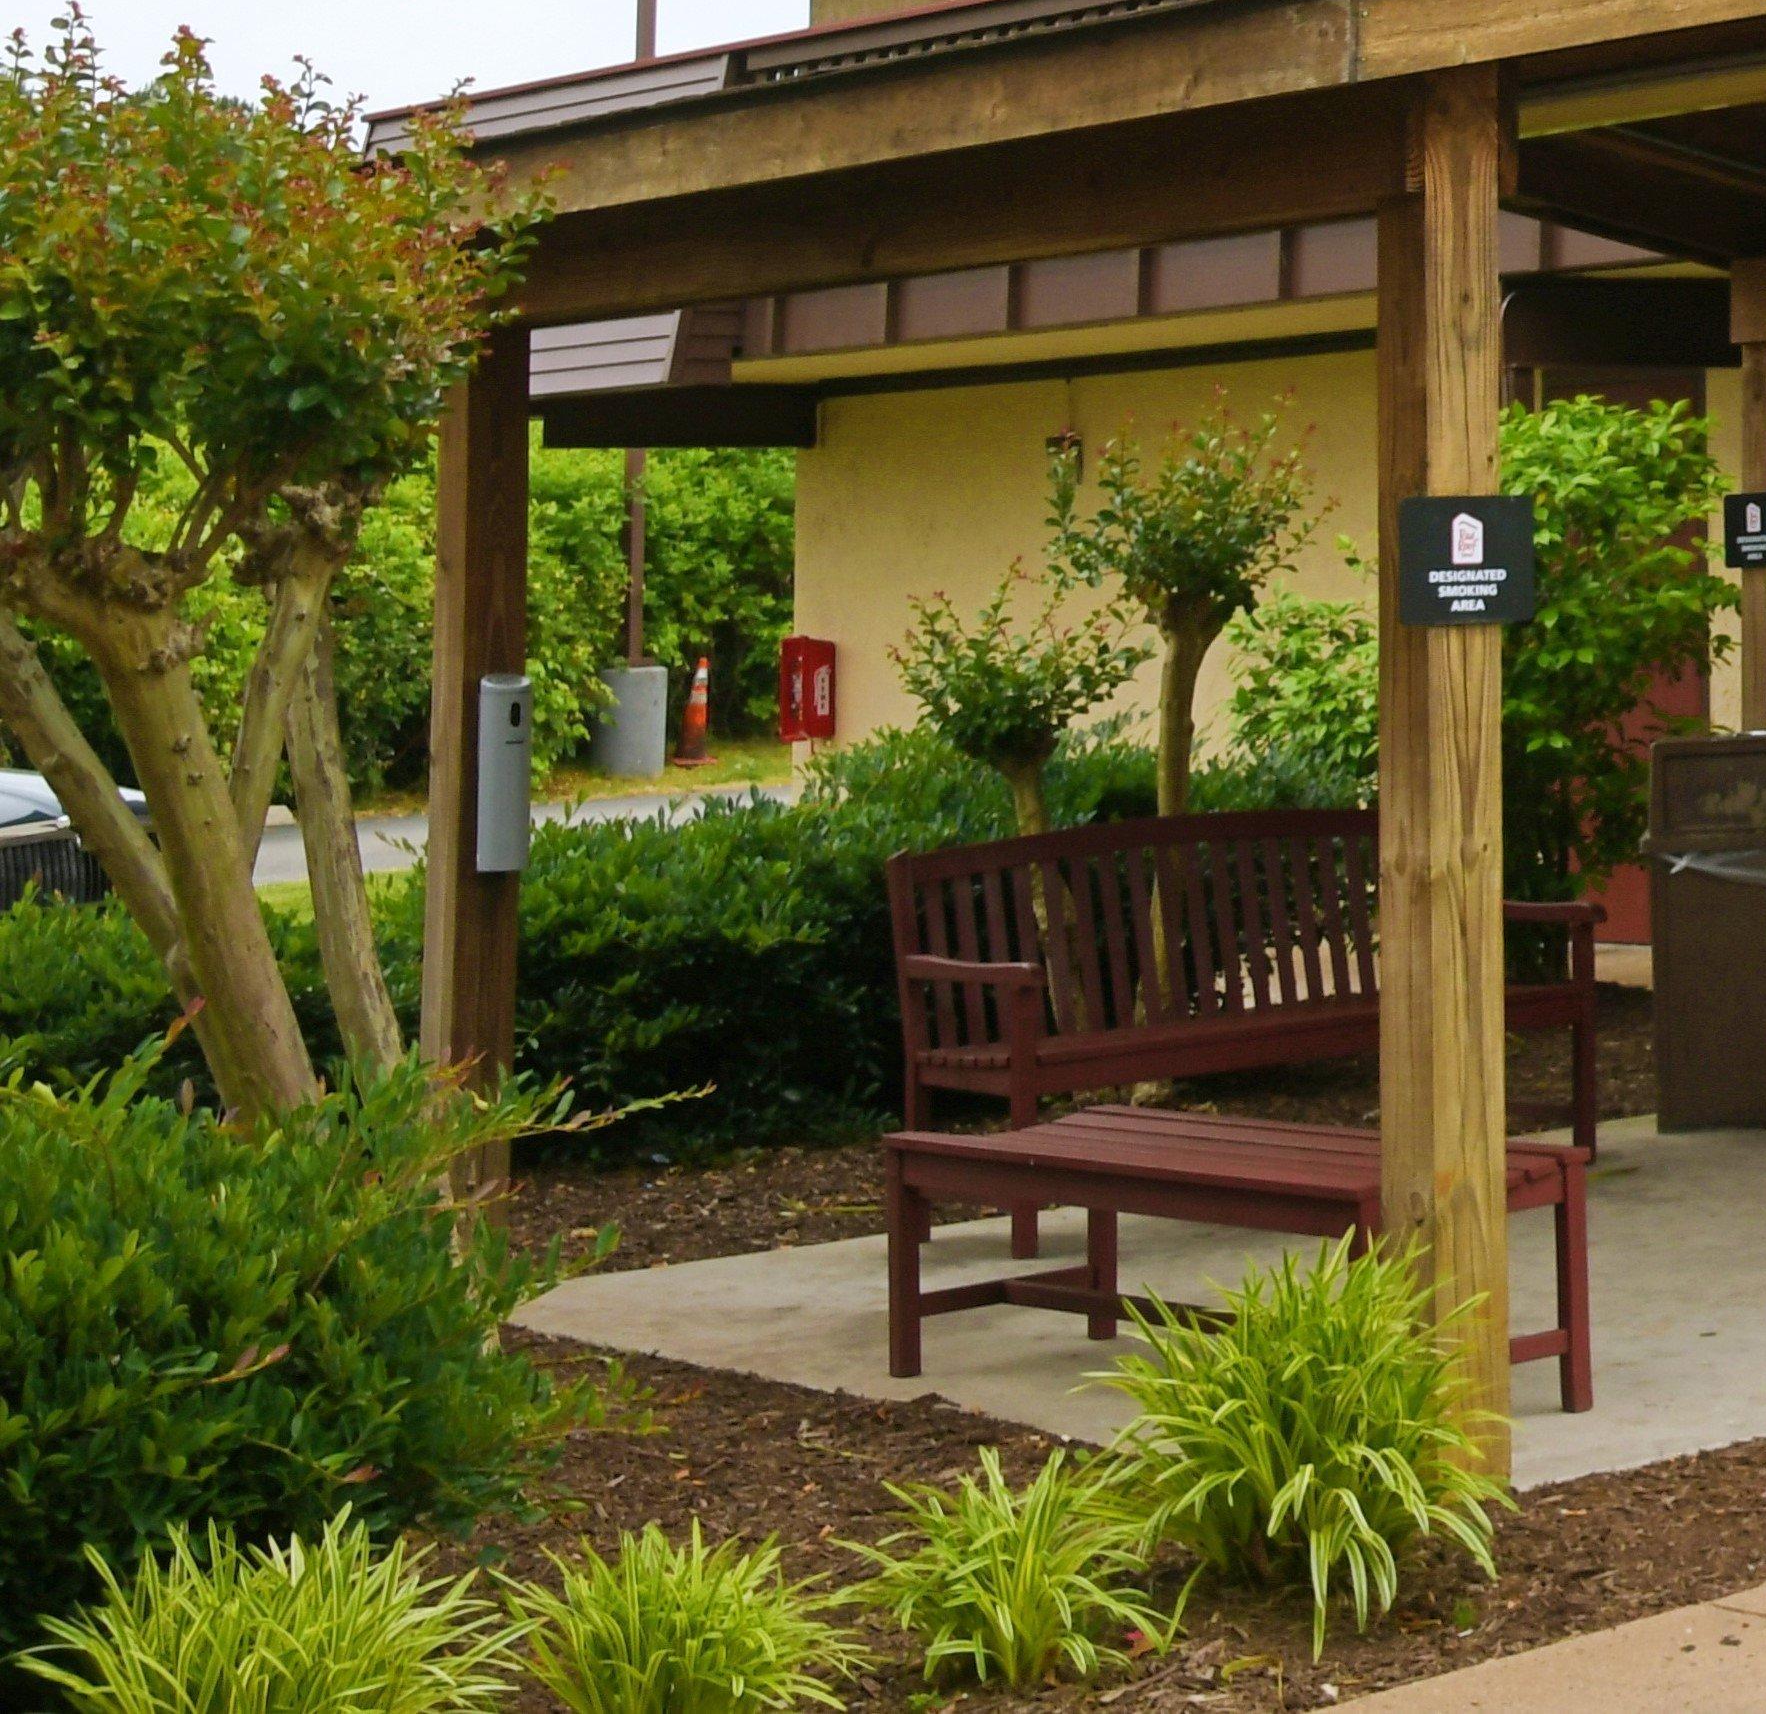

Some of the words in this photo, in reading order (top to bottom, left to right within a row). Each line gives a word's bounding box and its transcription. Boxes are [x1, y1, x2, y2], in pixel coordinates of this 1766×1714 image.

[1428, 569, 1507, 583] DESIGNATED
[1437, 584, 1498, 598] SMOKING
[1450, 599, 1486, 612] AREA
